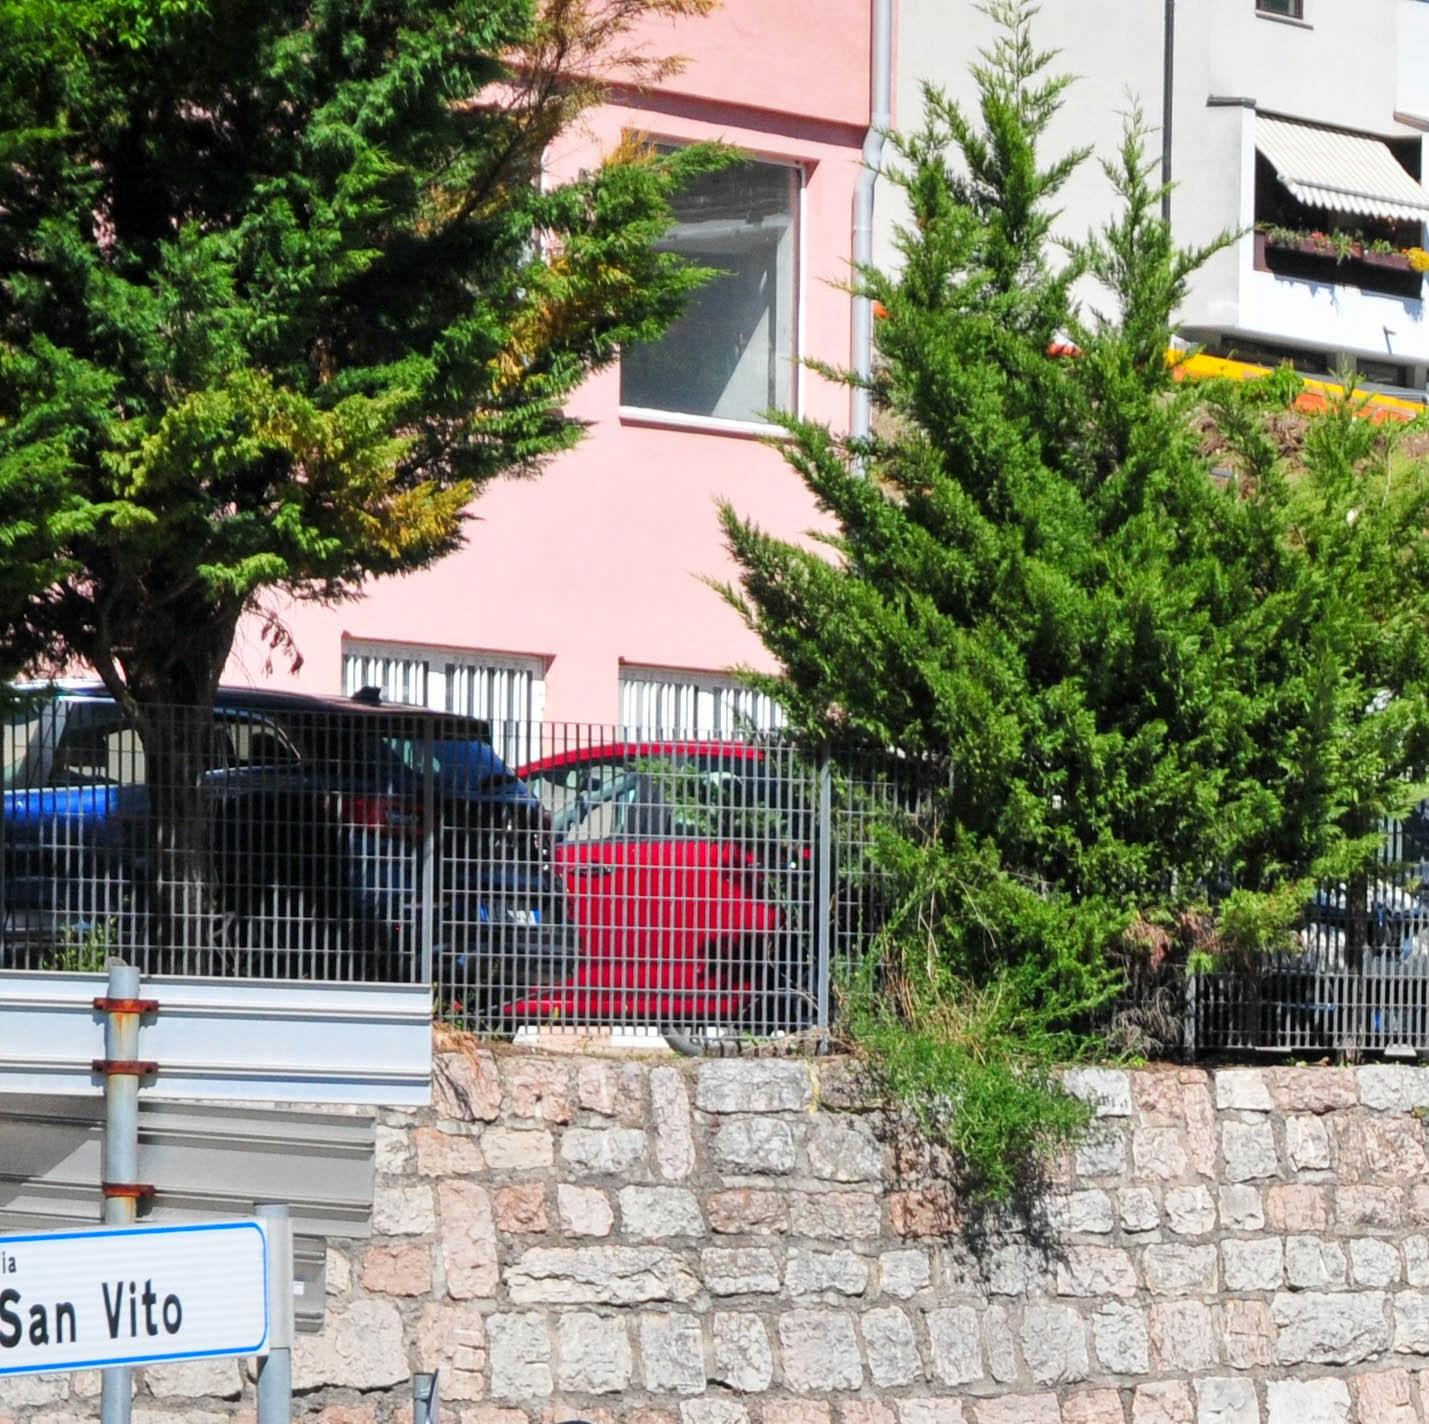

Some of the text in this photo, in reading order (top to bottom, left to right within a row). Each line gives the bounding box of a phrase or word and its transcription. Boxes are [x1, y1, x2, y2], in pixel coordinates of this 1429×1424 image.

[0, 1251, 17, 1274] ia
[0, 1278, 183, 1349] San Vito
